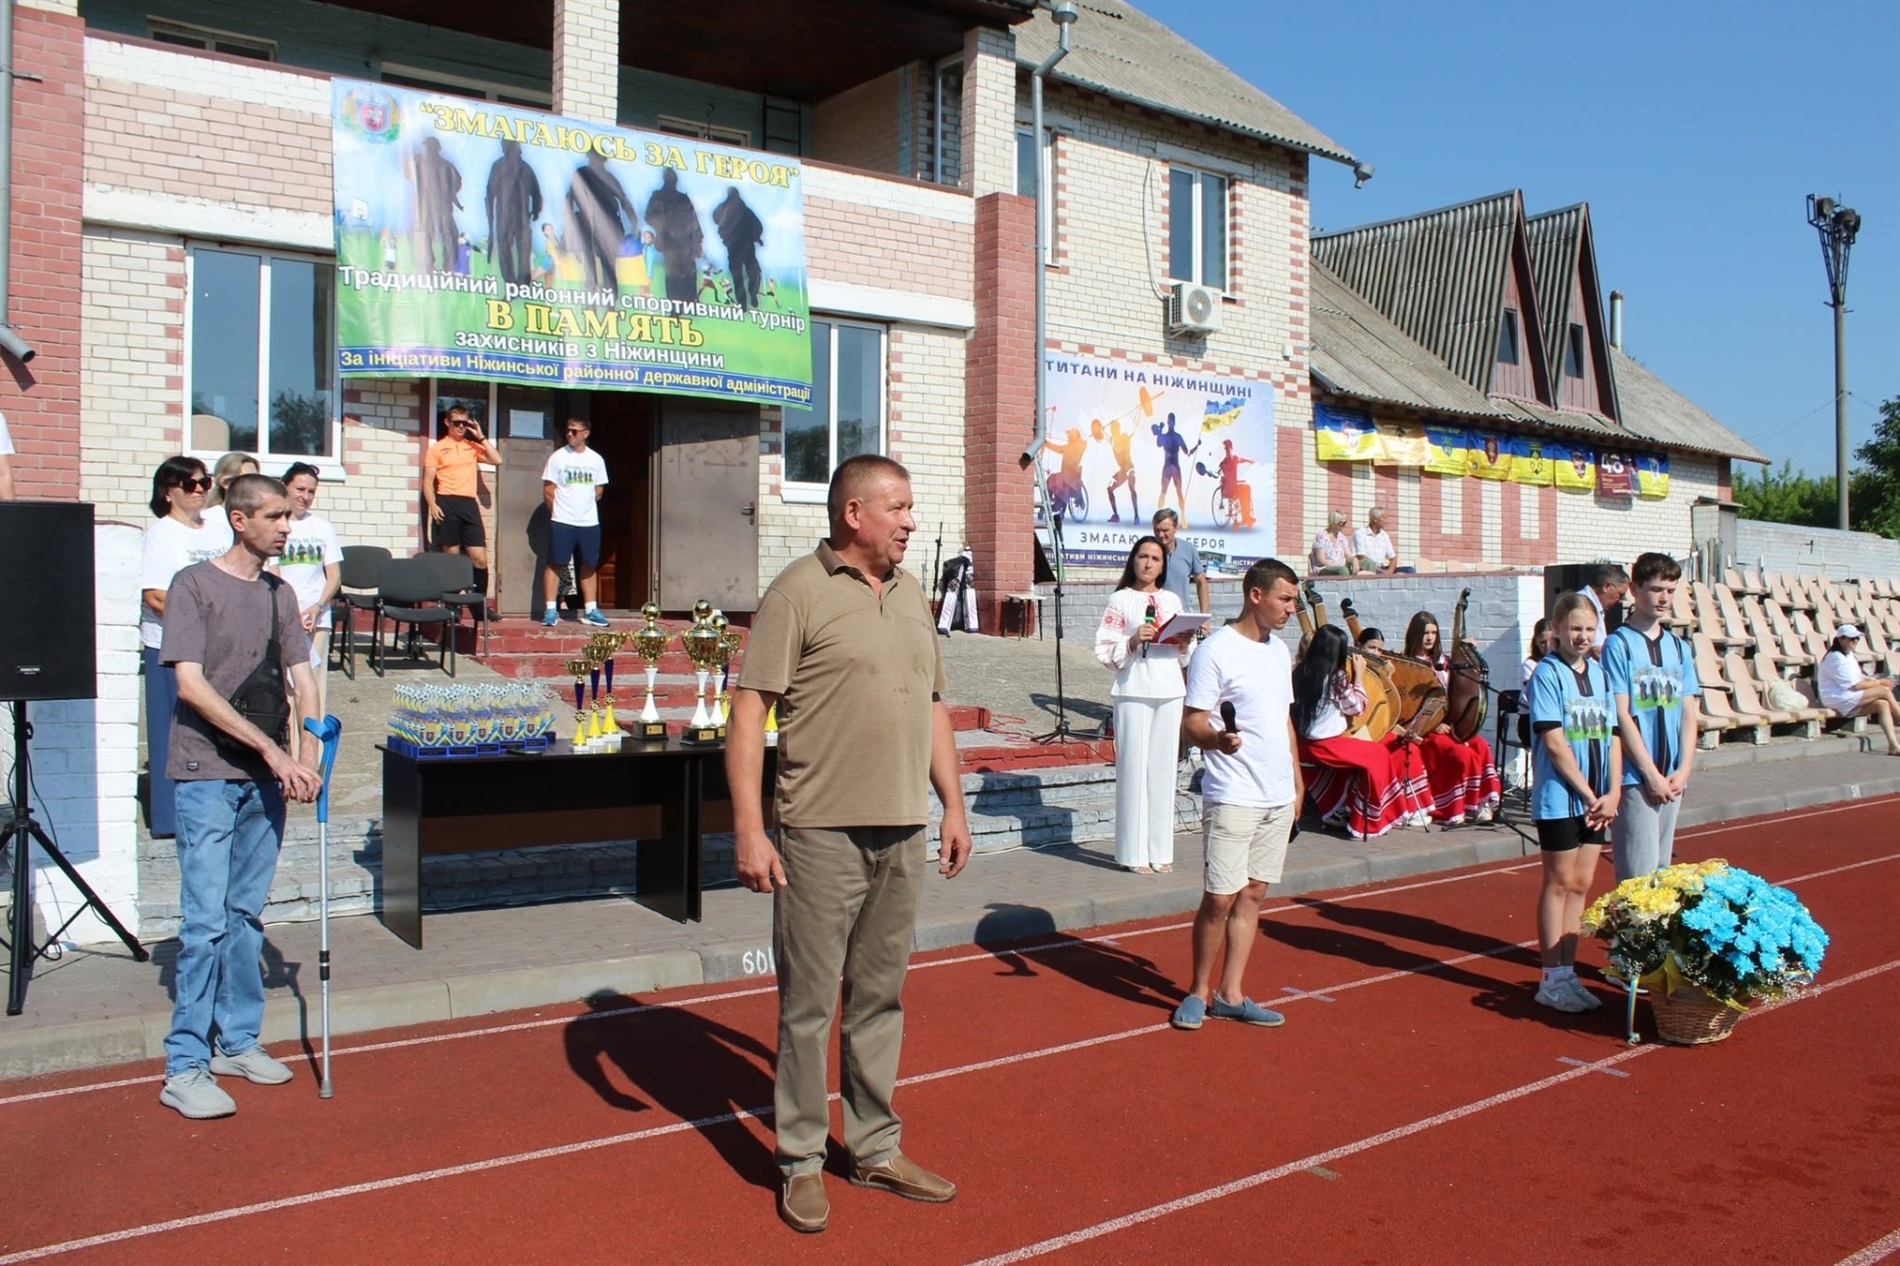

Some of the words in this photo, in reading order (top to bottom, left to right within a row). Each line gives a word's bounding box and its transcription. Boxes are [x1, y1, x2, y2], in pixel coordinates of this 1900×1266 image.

[644, 142, 688, 171] ЗА
[338, 265, 498, 296] Традиційний
[505, 281, 615, 306] районний
[621, 294, 744, 322] спортивний
[749, 309, 805, 333] турнір
[486, 299, 514, 330] В
[525, 303, 704, 347] ПАМ'ЯТЬ
[454, 331, 580, 358] захисників
[586, 345, 598, 359] з
[604, 341, 725, 369] Ніжинщини
[341, 352, 363, 366] За
[368, 350, 461, 369] ініціативи
[466, 354, 559, 377] Ніжинської
[563, 364, 640, 382] районної
[643, 370, 723, 389] державної
[726, 378, 811, 402] адміністрації
[1045, 360, 1118, 379] ТИТАНИ
[1124, 369, 1147, 383] НА
[1153, 374, 1251, 398] НІЖИНЩИНІ
[1080, 532, 1139, 545] ЗМАГАЮ
[1087, 553, 1130, 561] НІЖИНСЬКО
